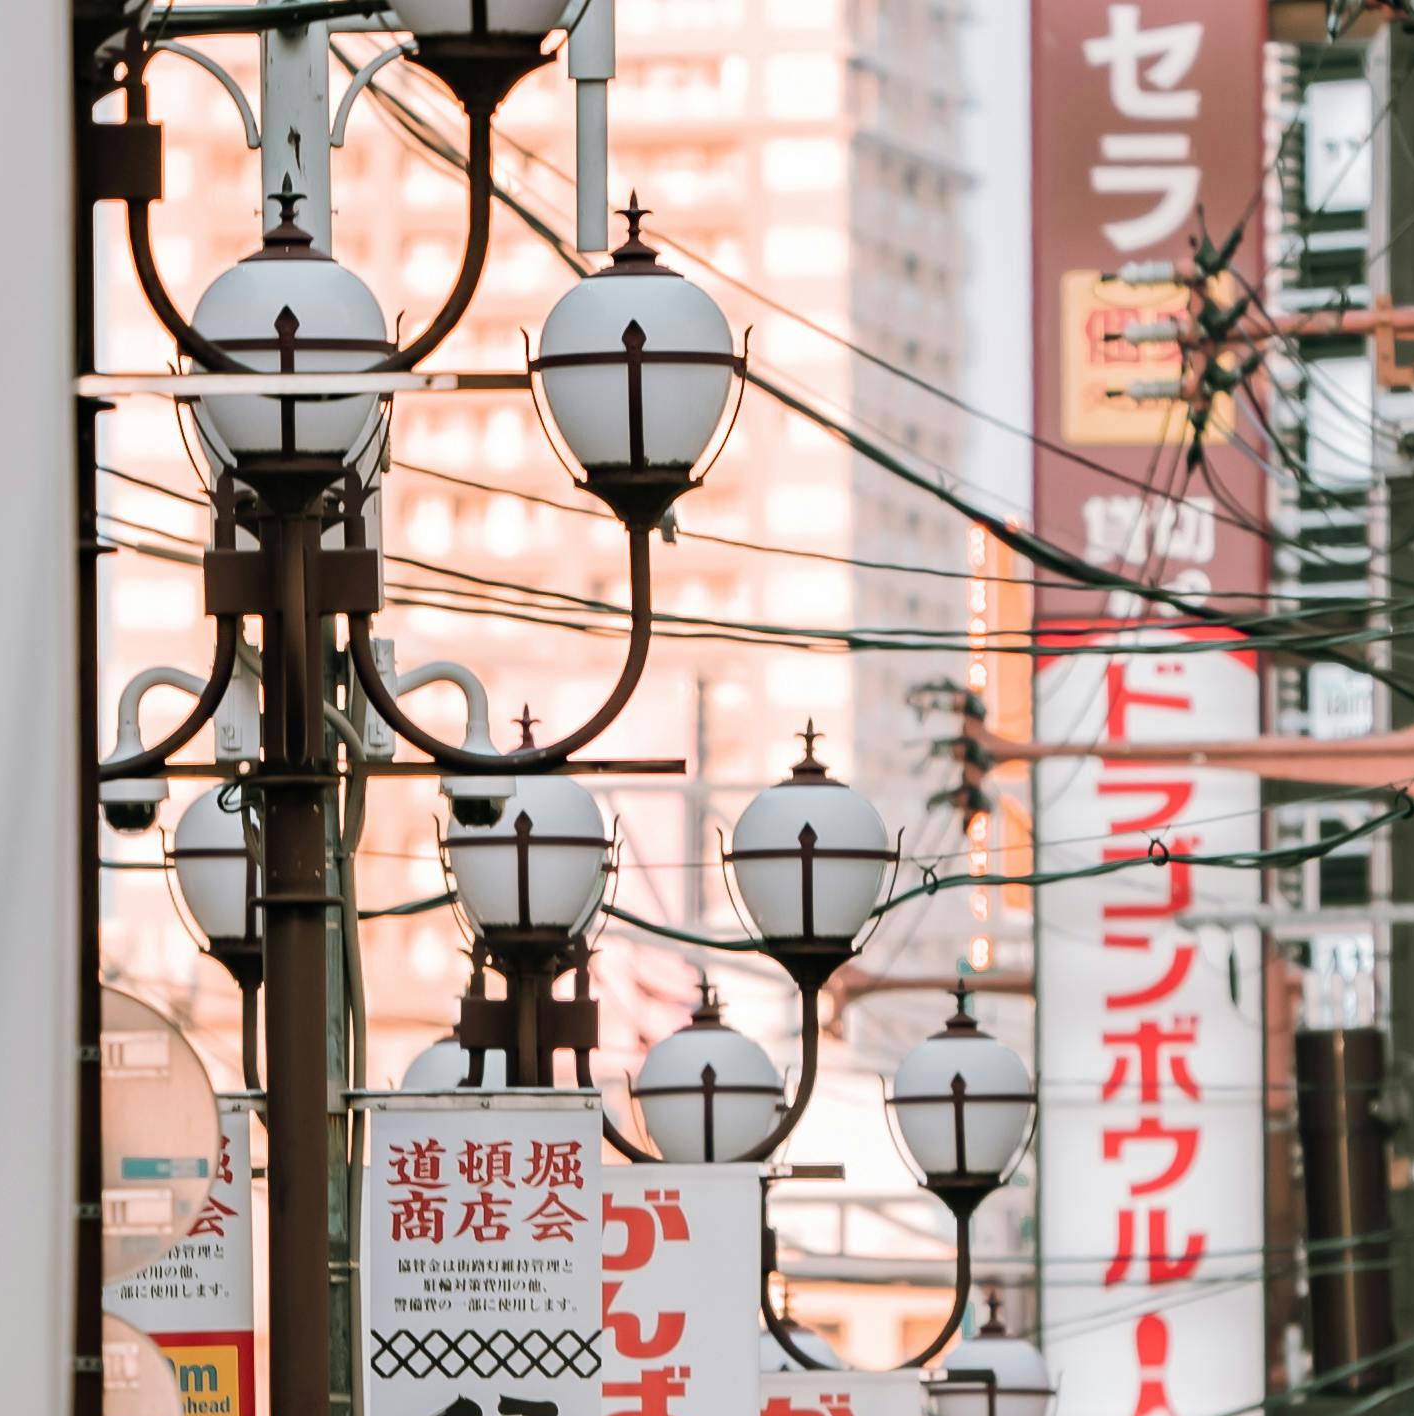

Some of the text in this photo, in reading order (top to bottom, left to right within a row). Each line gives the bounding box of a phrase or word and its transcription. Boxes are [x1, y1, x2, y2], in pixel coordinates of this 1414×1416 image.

[386, 1137, 587, 1189] 道頓堀
[386, 1190, 589, 1244] 商店会
[183, 1396, 231, 1414] head
